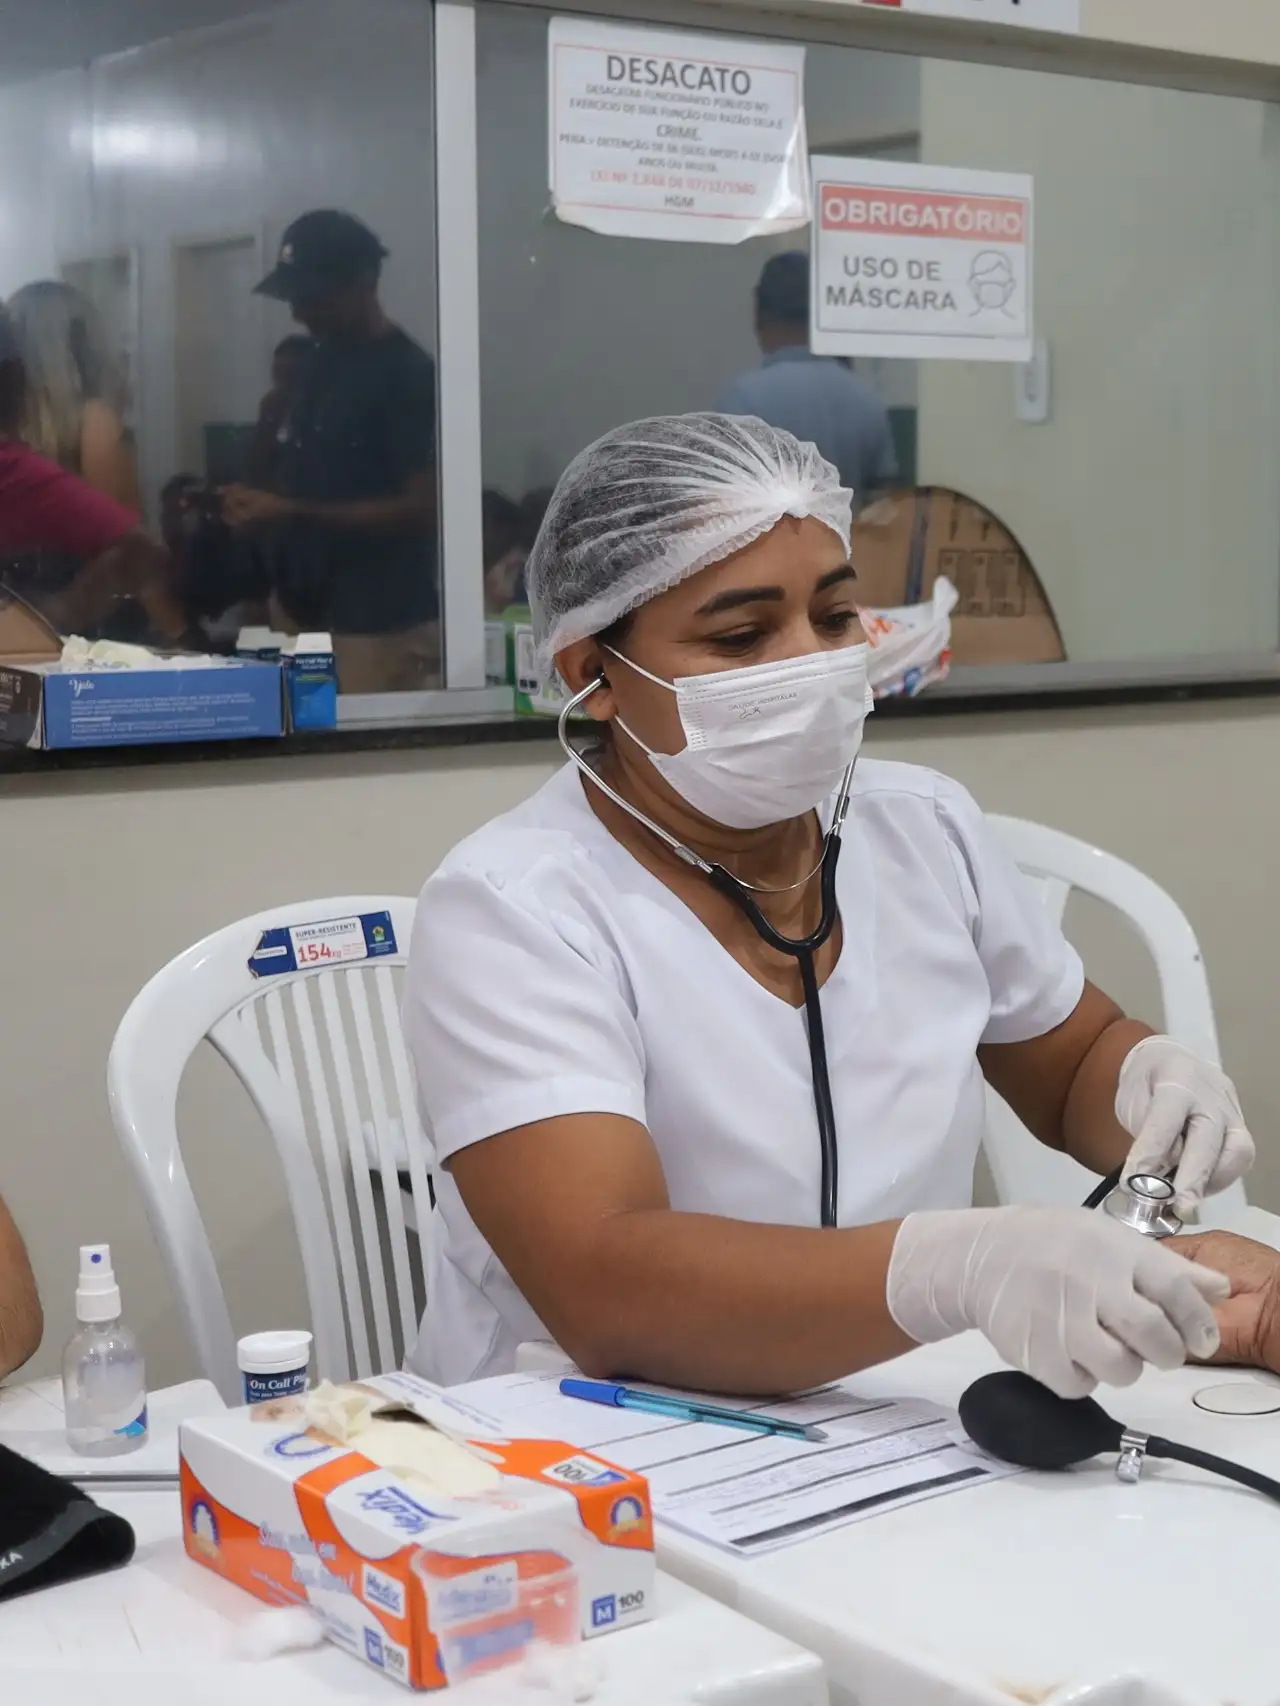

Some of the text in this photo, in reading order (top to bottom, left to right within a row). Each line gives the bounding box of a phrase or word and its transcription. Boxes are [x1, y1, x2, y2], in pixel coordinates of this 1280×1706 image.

[606, 55, 751, 96] DESACATO
[824, 196, 1021, 236] OBRIGATÓRIO
[843, 255, 942, 281] USO DE
[825, 281, 958, 311] MÁSCARA
[250, 1379, 266, 1390] On
[268, 1378, 290, 1390] Call
[553, 1463, 588, 1482] 100
[618, 1590, 645, 1608] 100
